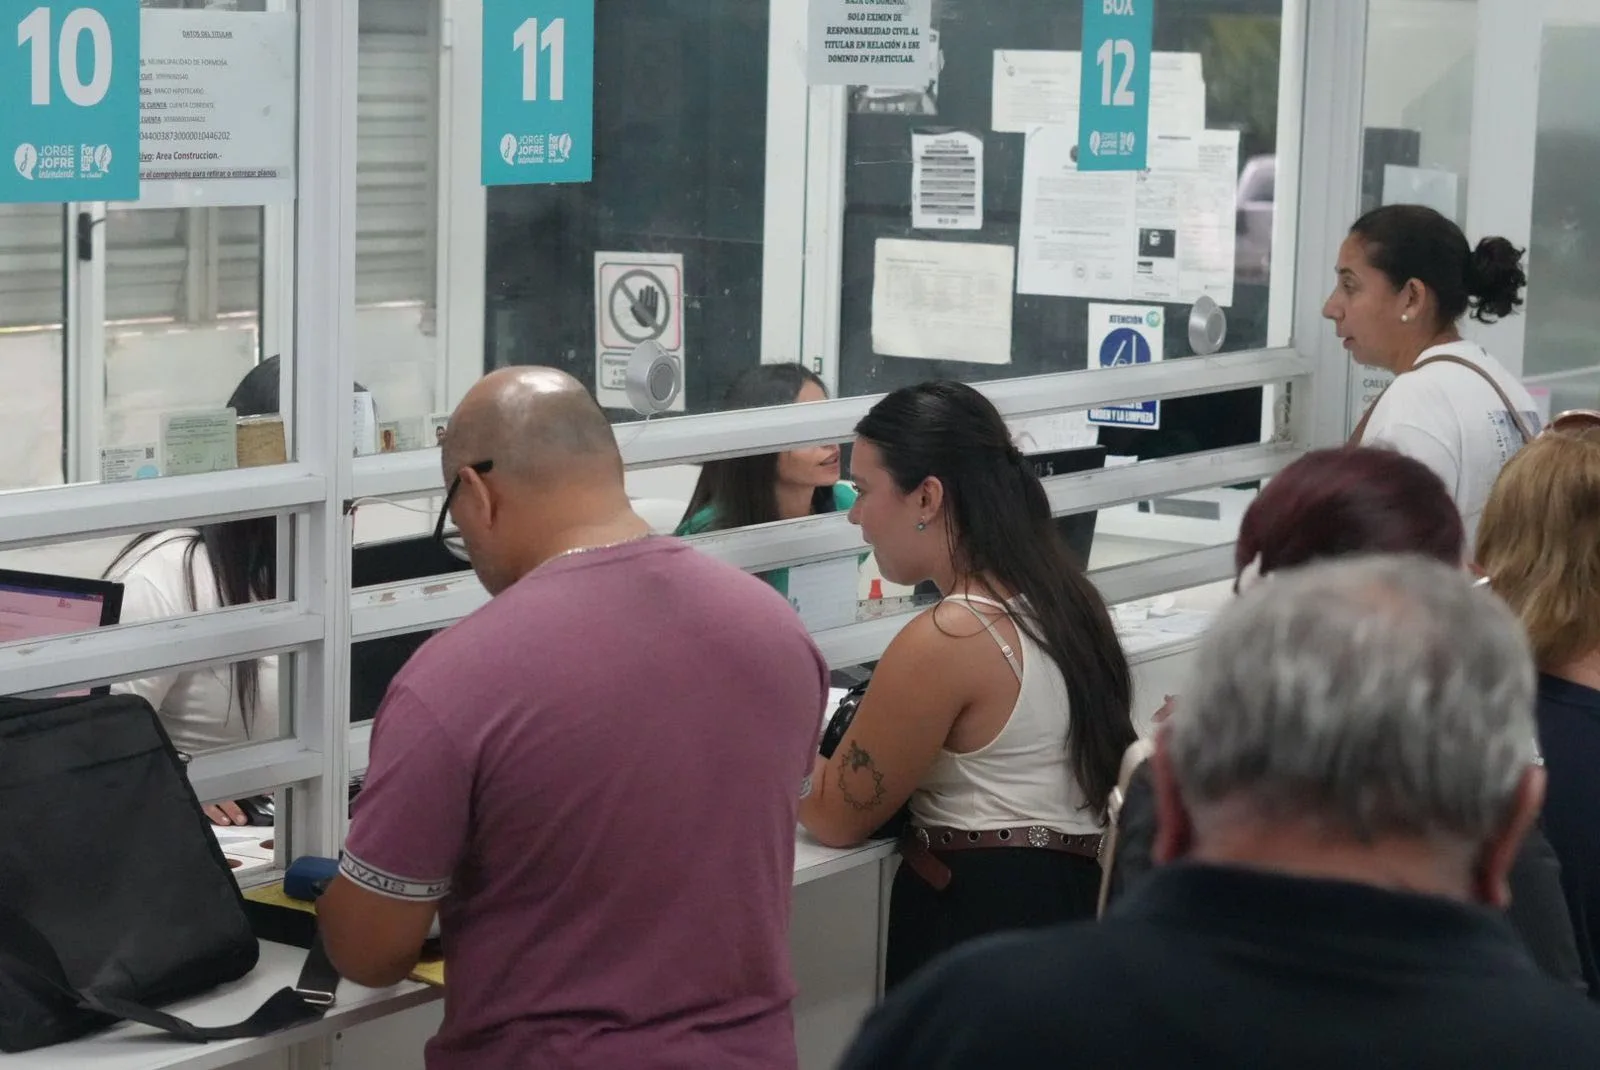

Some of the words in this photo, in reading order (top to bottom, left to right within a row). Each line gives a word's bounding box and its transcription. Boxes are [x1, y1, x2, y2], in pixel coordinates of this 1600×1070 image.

[1104, 0, 1134, 16] BOX
[847, 13, 865, 21] SOLO
[867, 13, 892, 22] EXIMEN
[893, 13, 902, 21] DE
[183, 30, 200, 39] DATOS
[826, 26, 890, 36] RESPONSABILIDAD
[892, 27, 909, 35] CIVIL
[911, 27, 919, 36] AL
[824, 40, 855, 49] TITULAR
[856, 40, 865, 49] EN
[867, 39, 901, 49] RELACIÓN
[902, 41, 907, 49] A
[908, 41, 920, 49] ESE
[17, 6, 113, 107] 10
[512, 17, 565, 101] 11
[828, 54, 858, 63] DOMINIO
[859, 54, 869, 63] EN
[870, 54, 915, 63] PARTICULAR.
[147, 58, 192, 66] MUNICIPALIDAD
[193, 59, 201, 67] DE
[1096, 39, 1135, 106] 12
[518, 134, 545, 145] JORGE
[38, 144, 75, 157] JORGE
[518, 145, 545, 155] JOFRE
[155, 151, 173, 161] Area
[38, 156, 75, 169] JOFRE
[152, 169, 192, 180] comprobante
[193, 169, 206, 179] para
[206, 168, 227, 178] retirar
[232, 168, 256, 179] entregar
[1109, 314, 1143, 324] ATENCIÓN
[1126, 410, 1154, 424] LIMPIEZA
